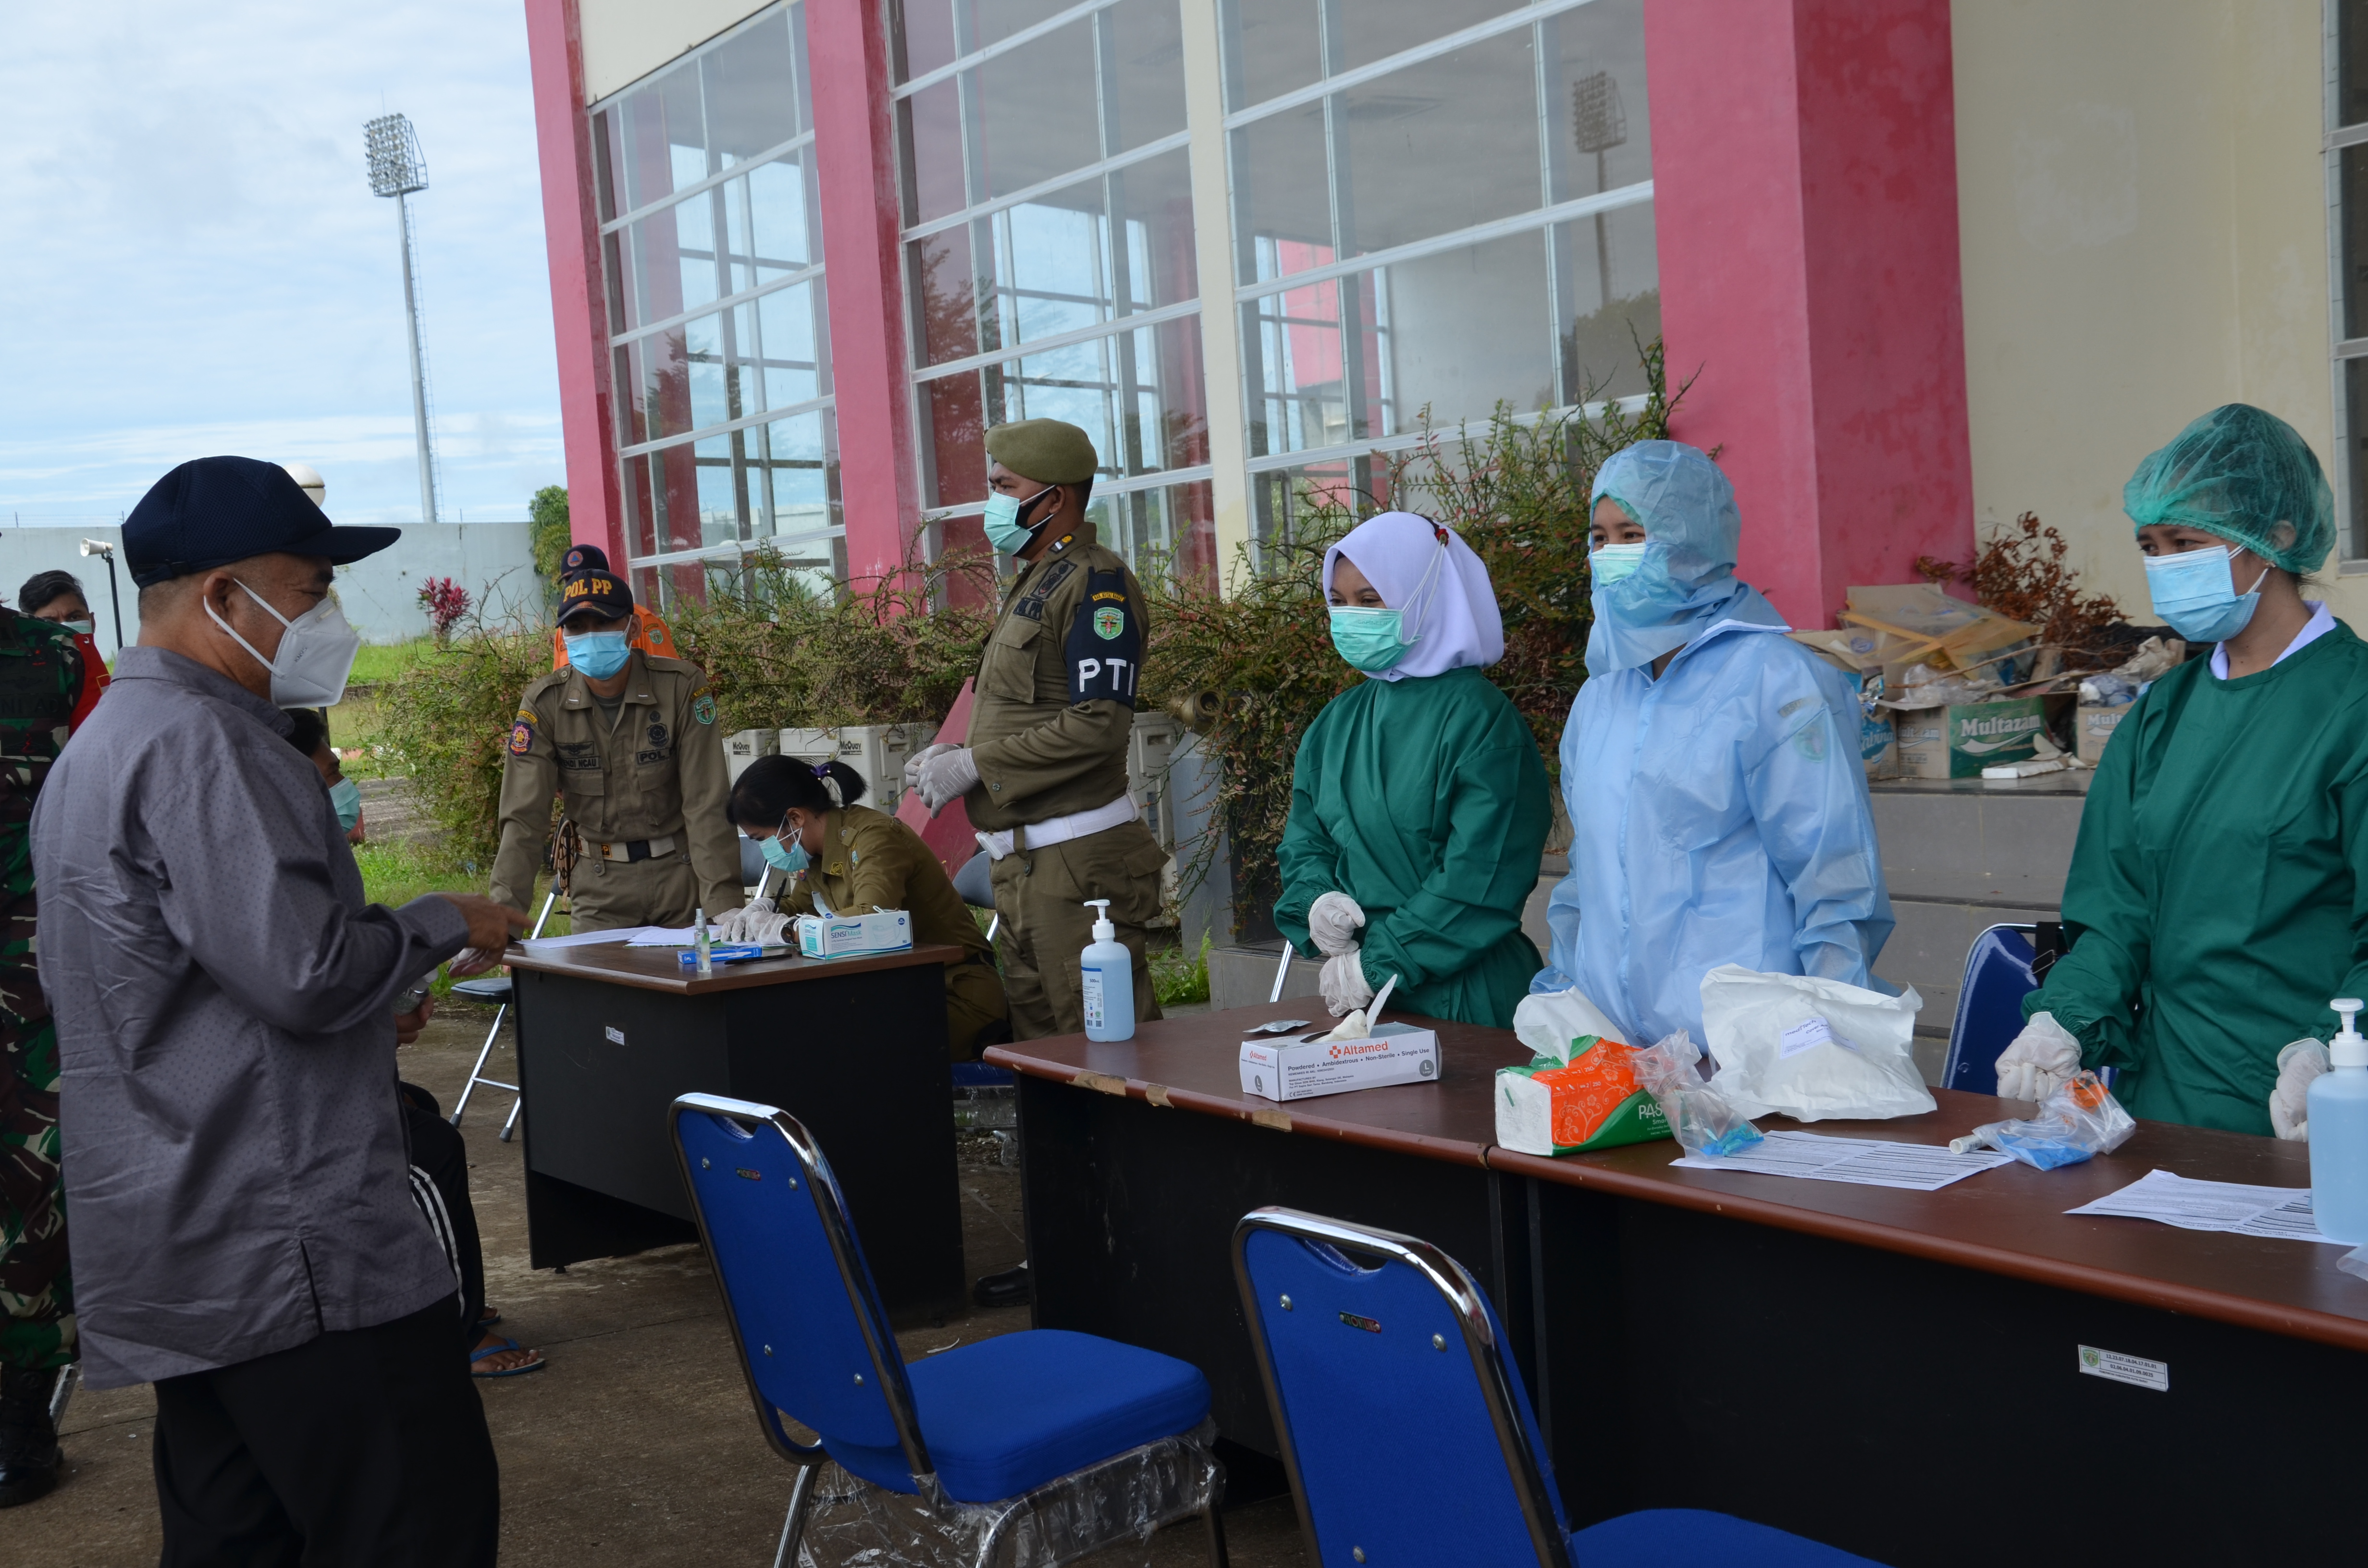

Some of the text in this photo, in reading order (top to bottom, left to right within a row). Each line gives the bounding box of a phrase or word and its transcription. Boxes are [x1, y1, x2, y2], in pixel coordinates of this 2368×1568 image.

[563, 577, 613, 603] POL PP
[294, 647, 308, 663] KN95
[1078, 658, 1135, 696] PTI
[1, 698, 61, 713] NI AD
[1961, 714, 2041, 737] Multazam
[2087, 713, 2124, 725] Mult
[733, 742, 750, 751] McQuay
[840, 741, 862, 750] McQuay
[562, 759, 576, 768] ENDI
[640, 750, 666, 762] POL
[831, 930, 847, 939] SENSI
[1344, 1041, 1389, 1056] Altamed
[1288, 1063, 1315, 1071] Powdered
[1322, 1058, 1359, 1067] Ambidextrous
[1365, 1053, 1395, 1061] Non-Sterile
[1639, 1102, 1663, 1120] PAS
